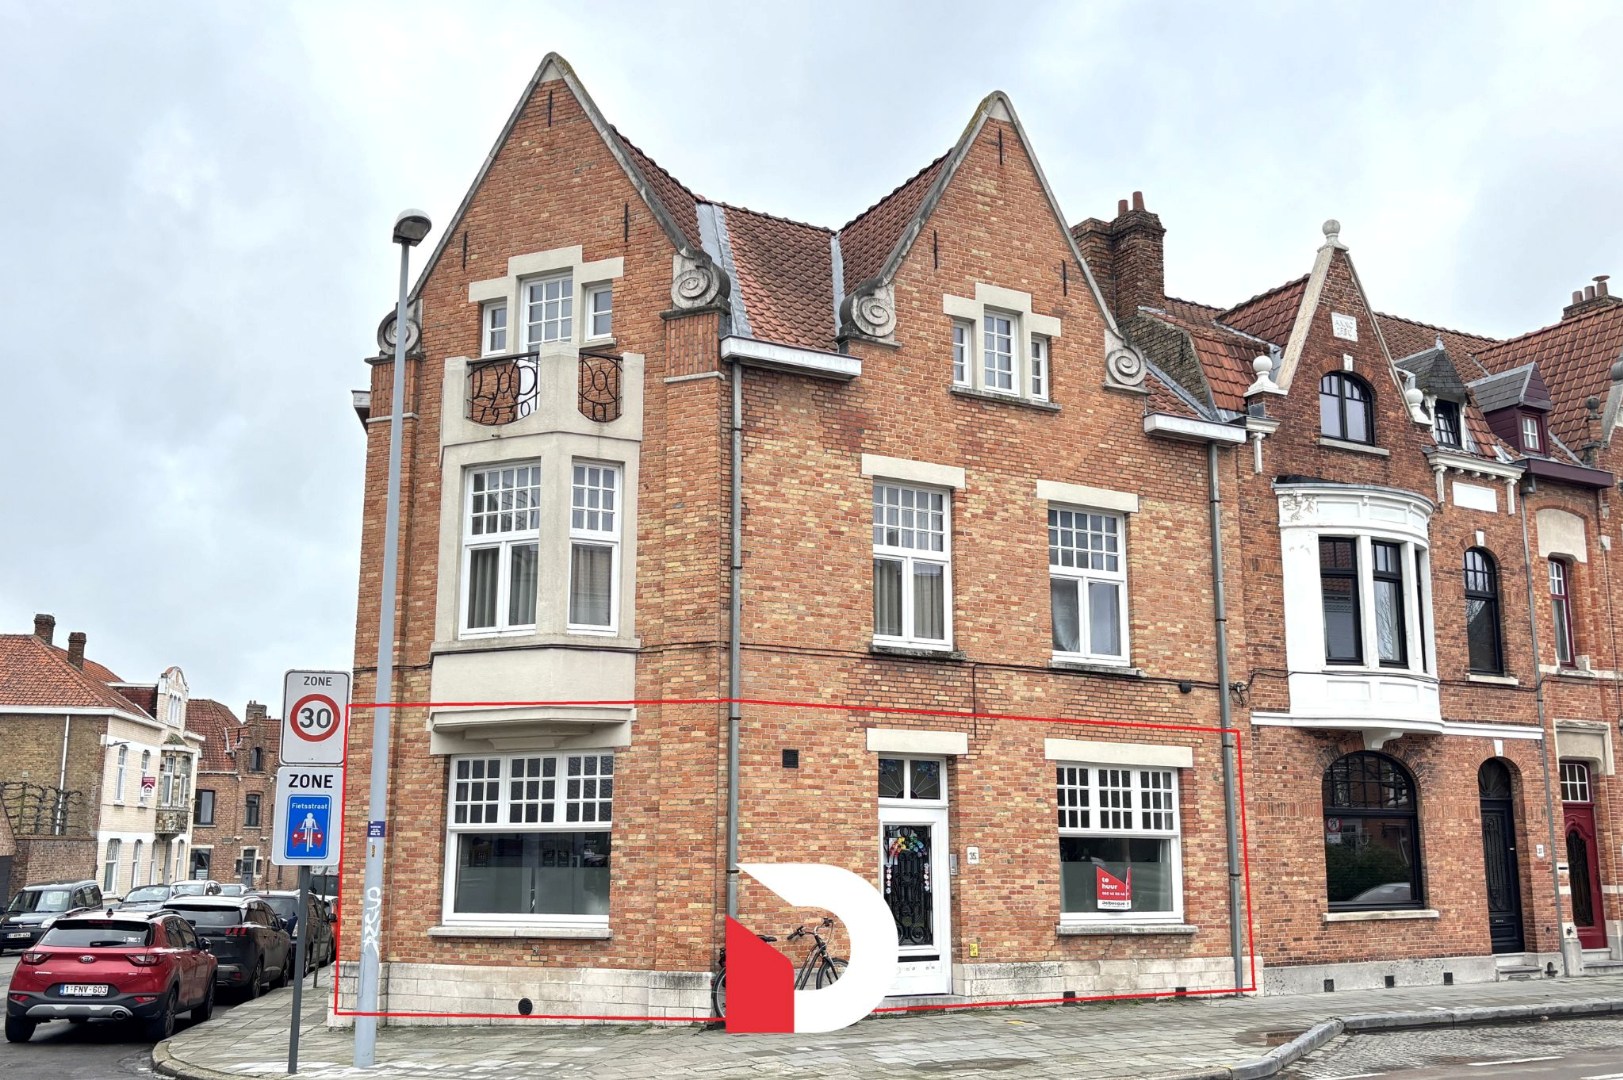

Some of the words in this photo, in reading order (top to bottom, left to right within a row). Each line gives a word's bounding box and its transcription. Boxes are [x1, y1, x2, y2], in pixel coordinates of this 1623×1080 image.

[303, 676, 333, 687] ZONE
[299, 707, 332, 729] 30
[288, 774, 334, 789] ZONE
[291, 802, 328, 810] Fietsstraat
